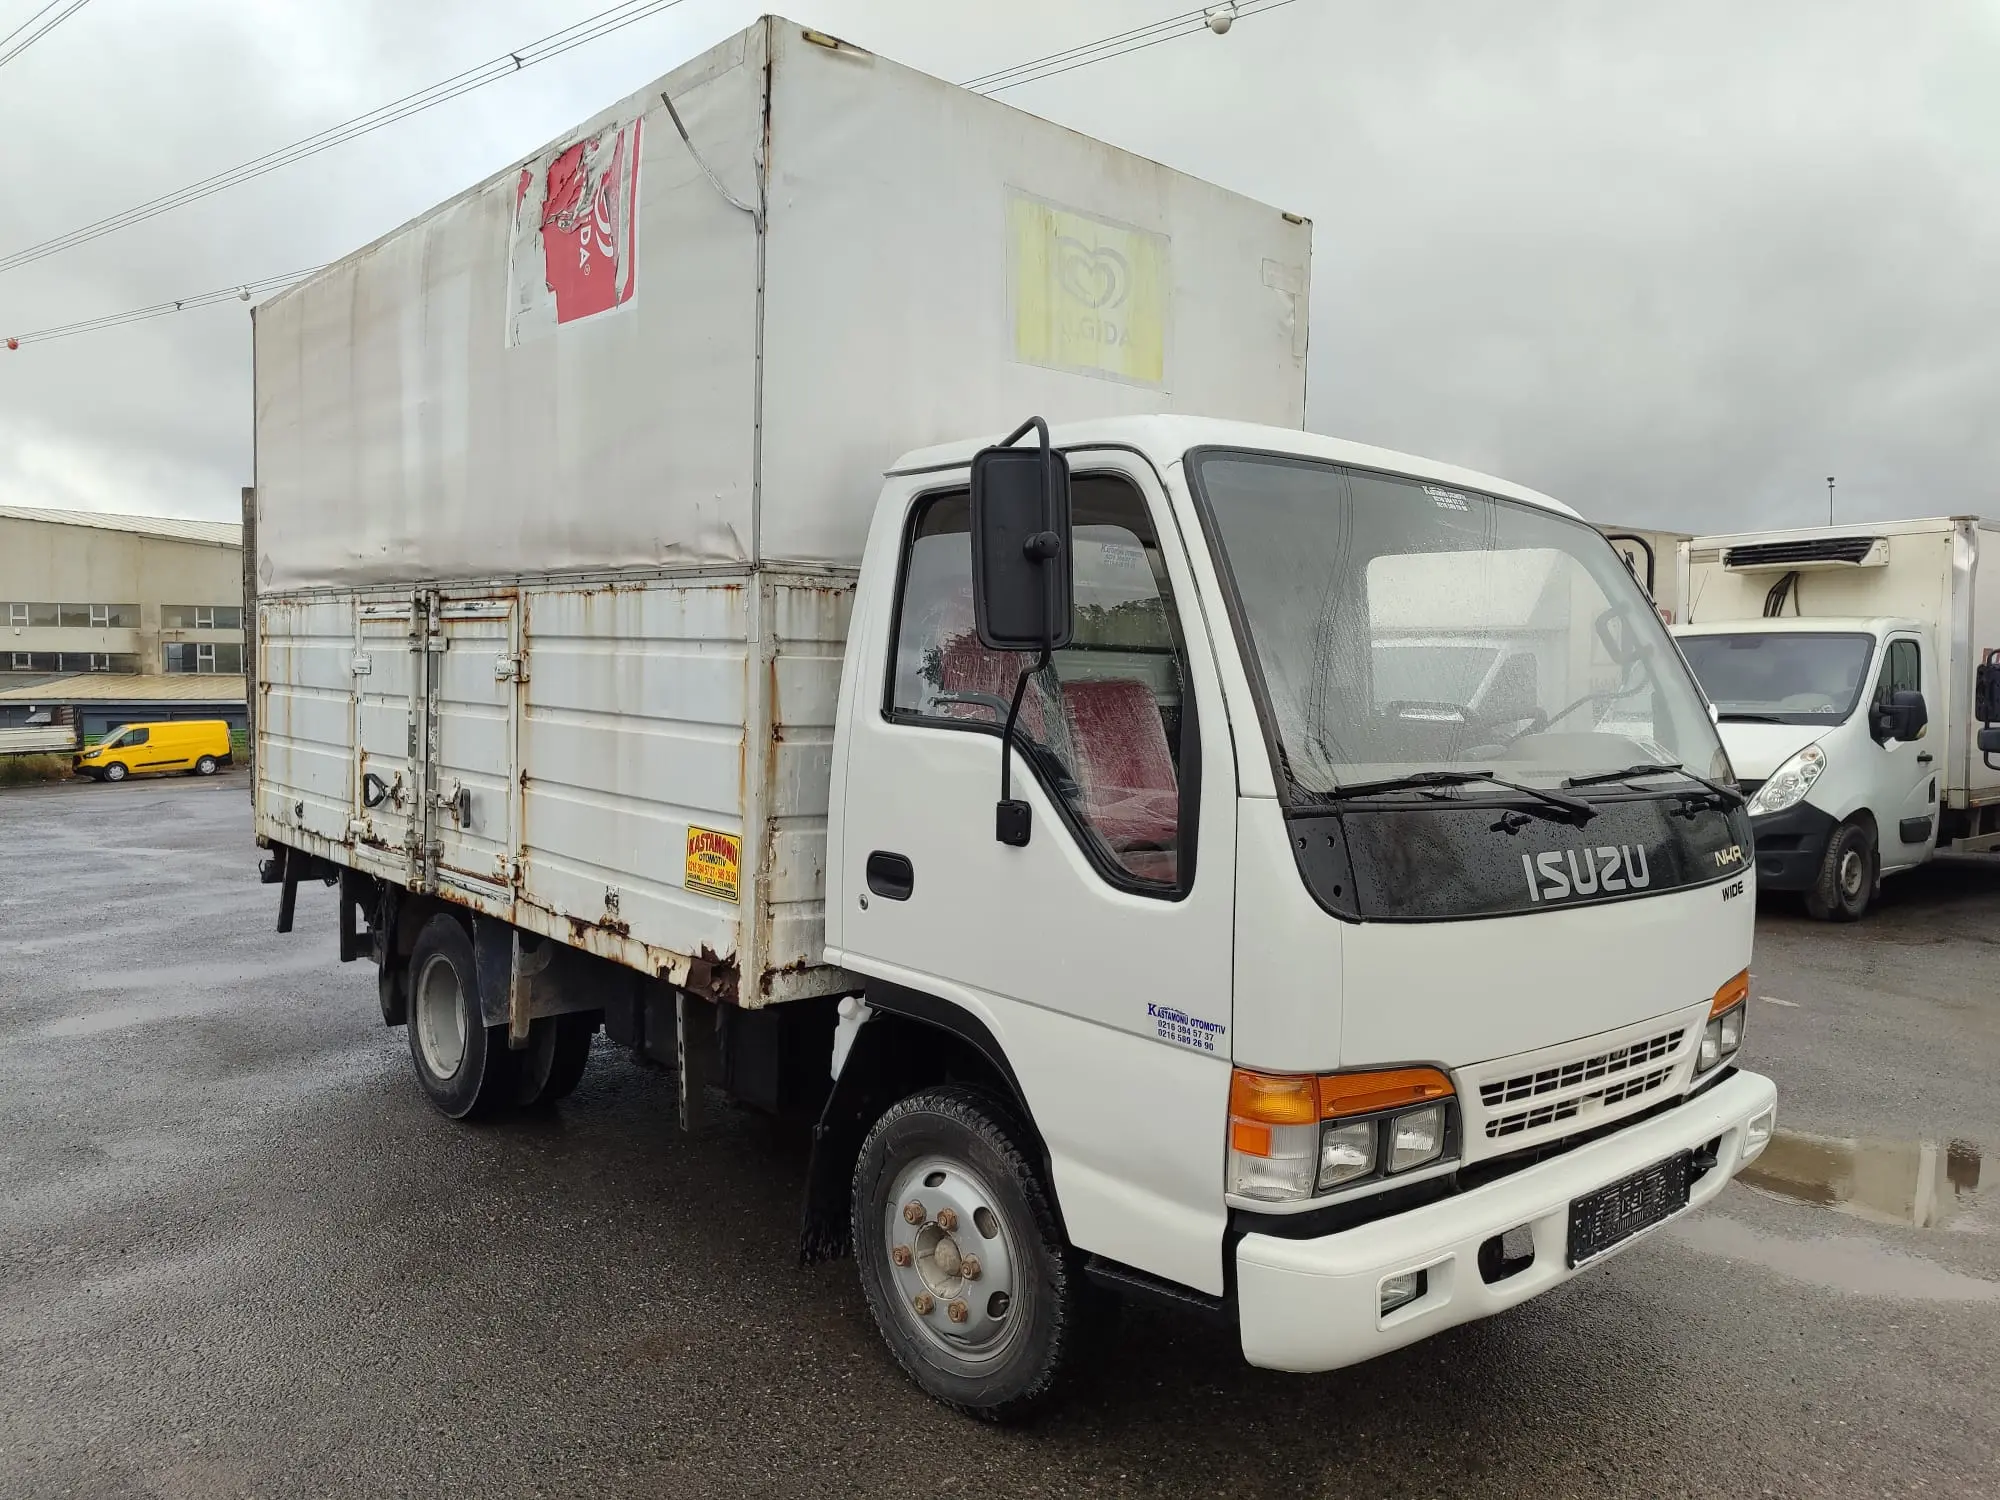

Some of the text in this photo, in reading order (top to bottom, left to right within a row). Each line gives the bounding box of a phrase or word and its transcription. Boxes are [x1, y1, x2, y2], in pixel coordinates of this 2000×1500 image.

[689, 833, 738, 866] KASTAMONU
[1522, 844, 1650, 902] ISUZU
[1722, 881, 1744, 902] WIDE
[1148, 1003, 1189, 1025] KASTAMONU
[1158, 1020, 1214, 1041] 0216 394 57 37
[1158, 1029, 1214, 1051] 0216 589 26 90
